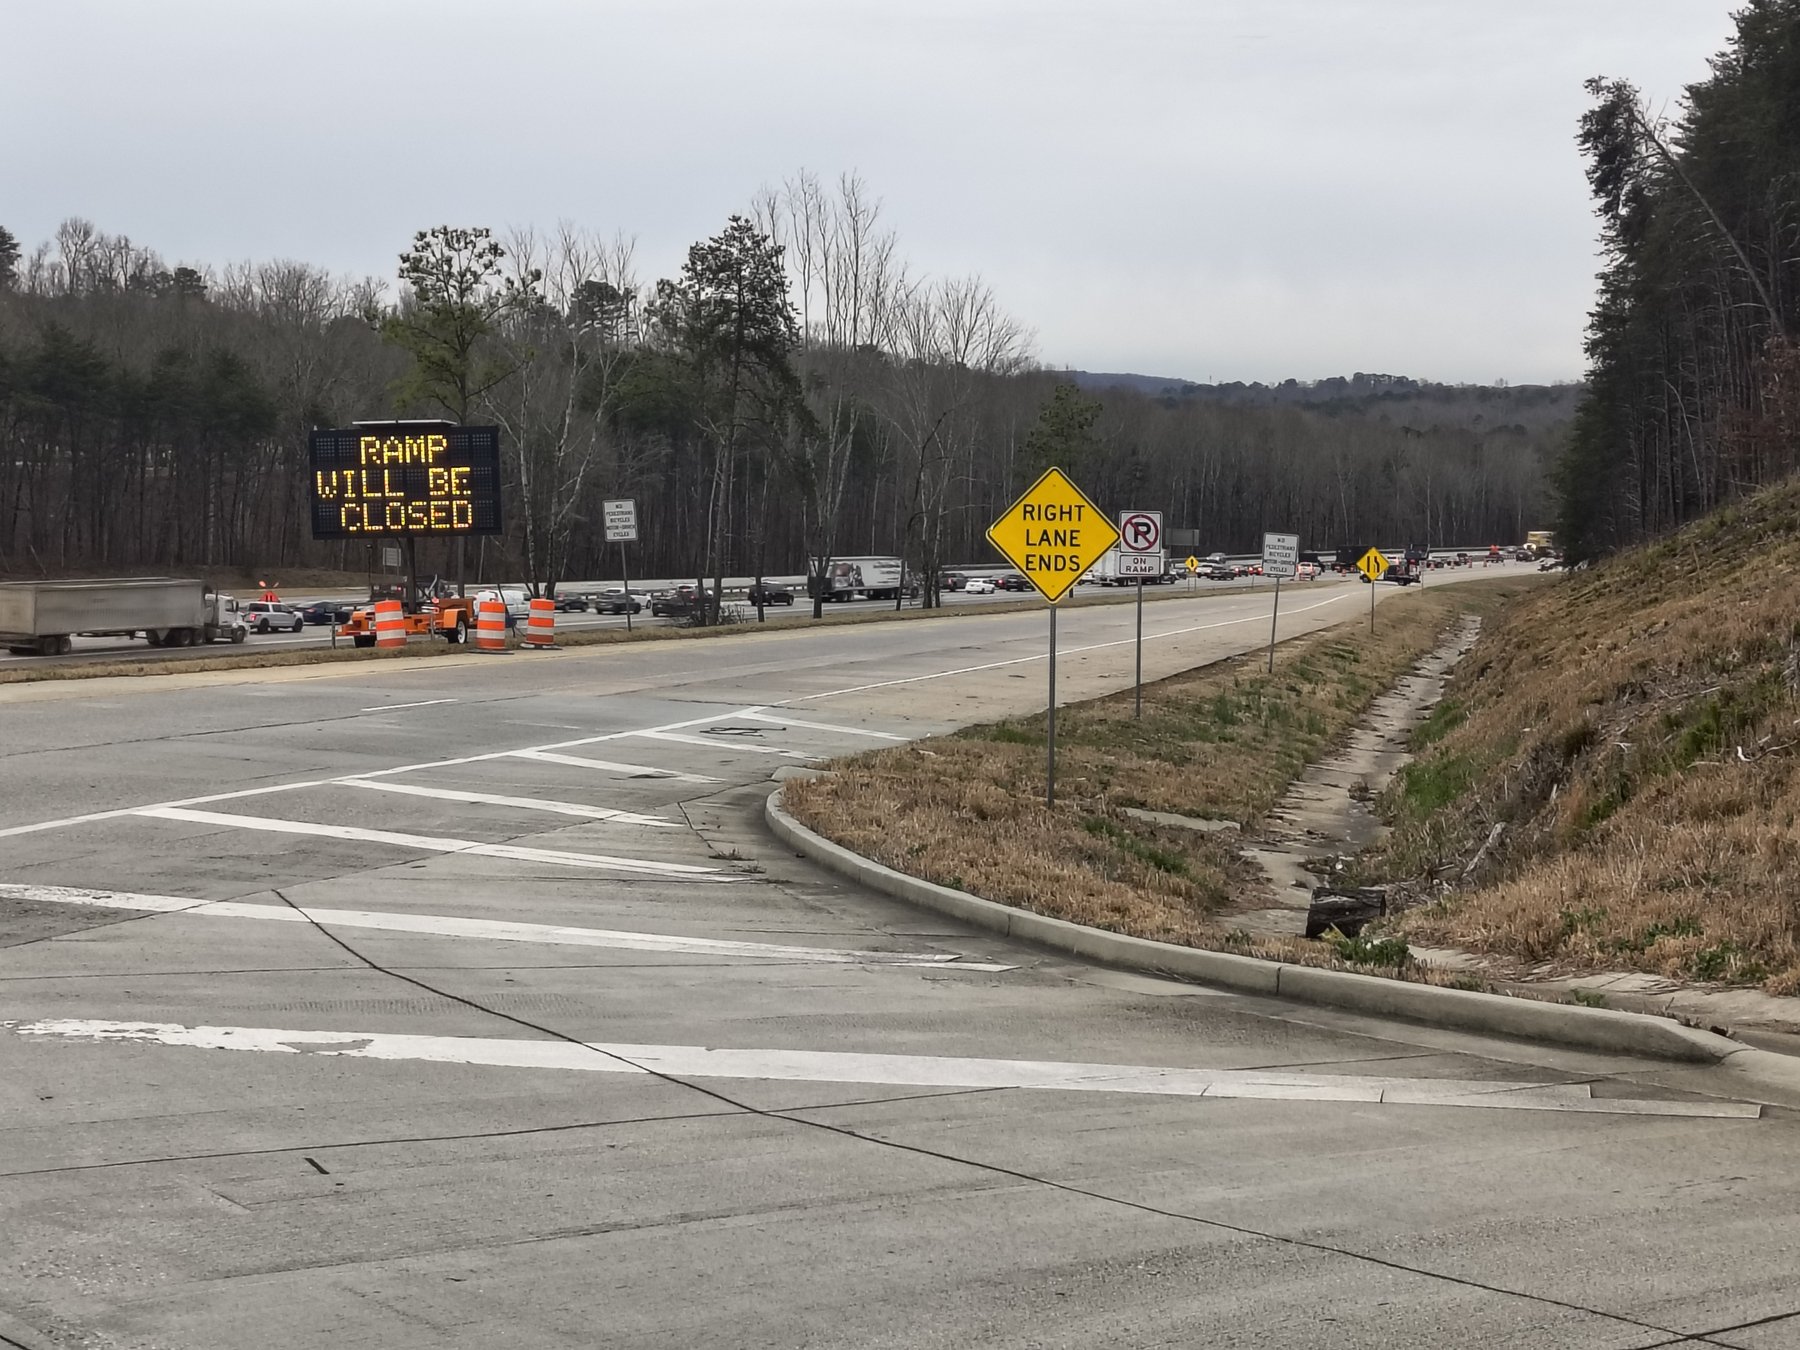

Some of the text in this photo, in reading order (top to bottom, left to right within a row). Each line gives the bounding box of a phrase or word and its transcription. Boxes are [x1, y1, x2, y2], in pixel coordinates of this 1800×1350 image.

[361, 435, 447, 464] RAMP
[317, 467, 471, 498] WILL BE
[341, 500, 472, 531] CLOSED
[1023, 504, 1085, 522] RIGHT
[1025, 529, 1081, 547] LANE
[1025, 554, 1080, 572] ENDS
[1125, 565, 1154, 573] RAMP
[1133, 557, 1146, 565] ON
